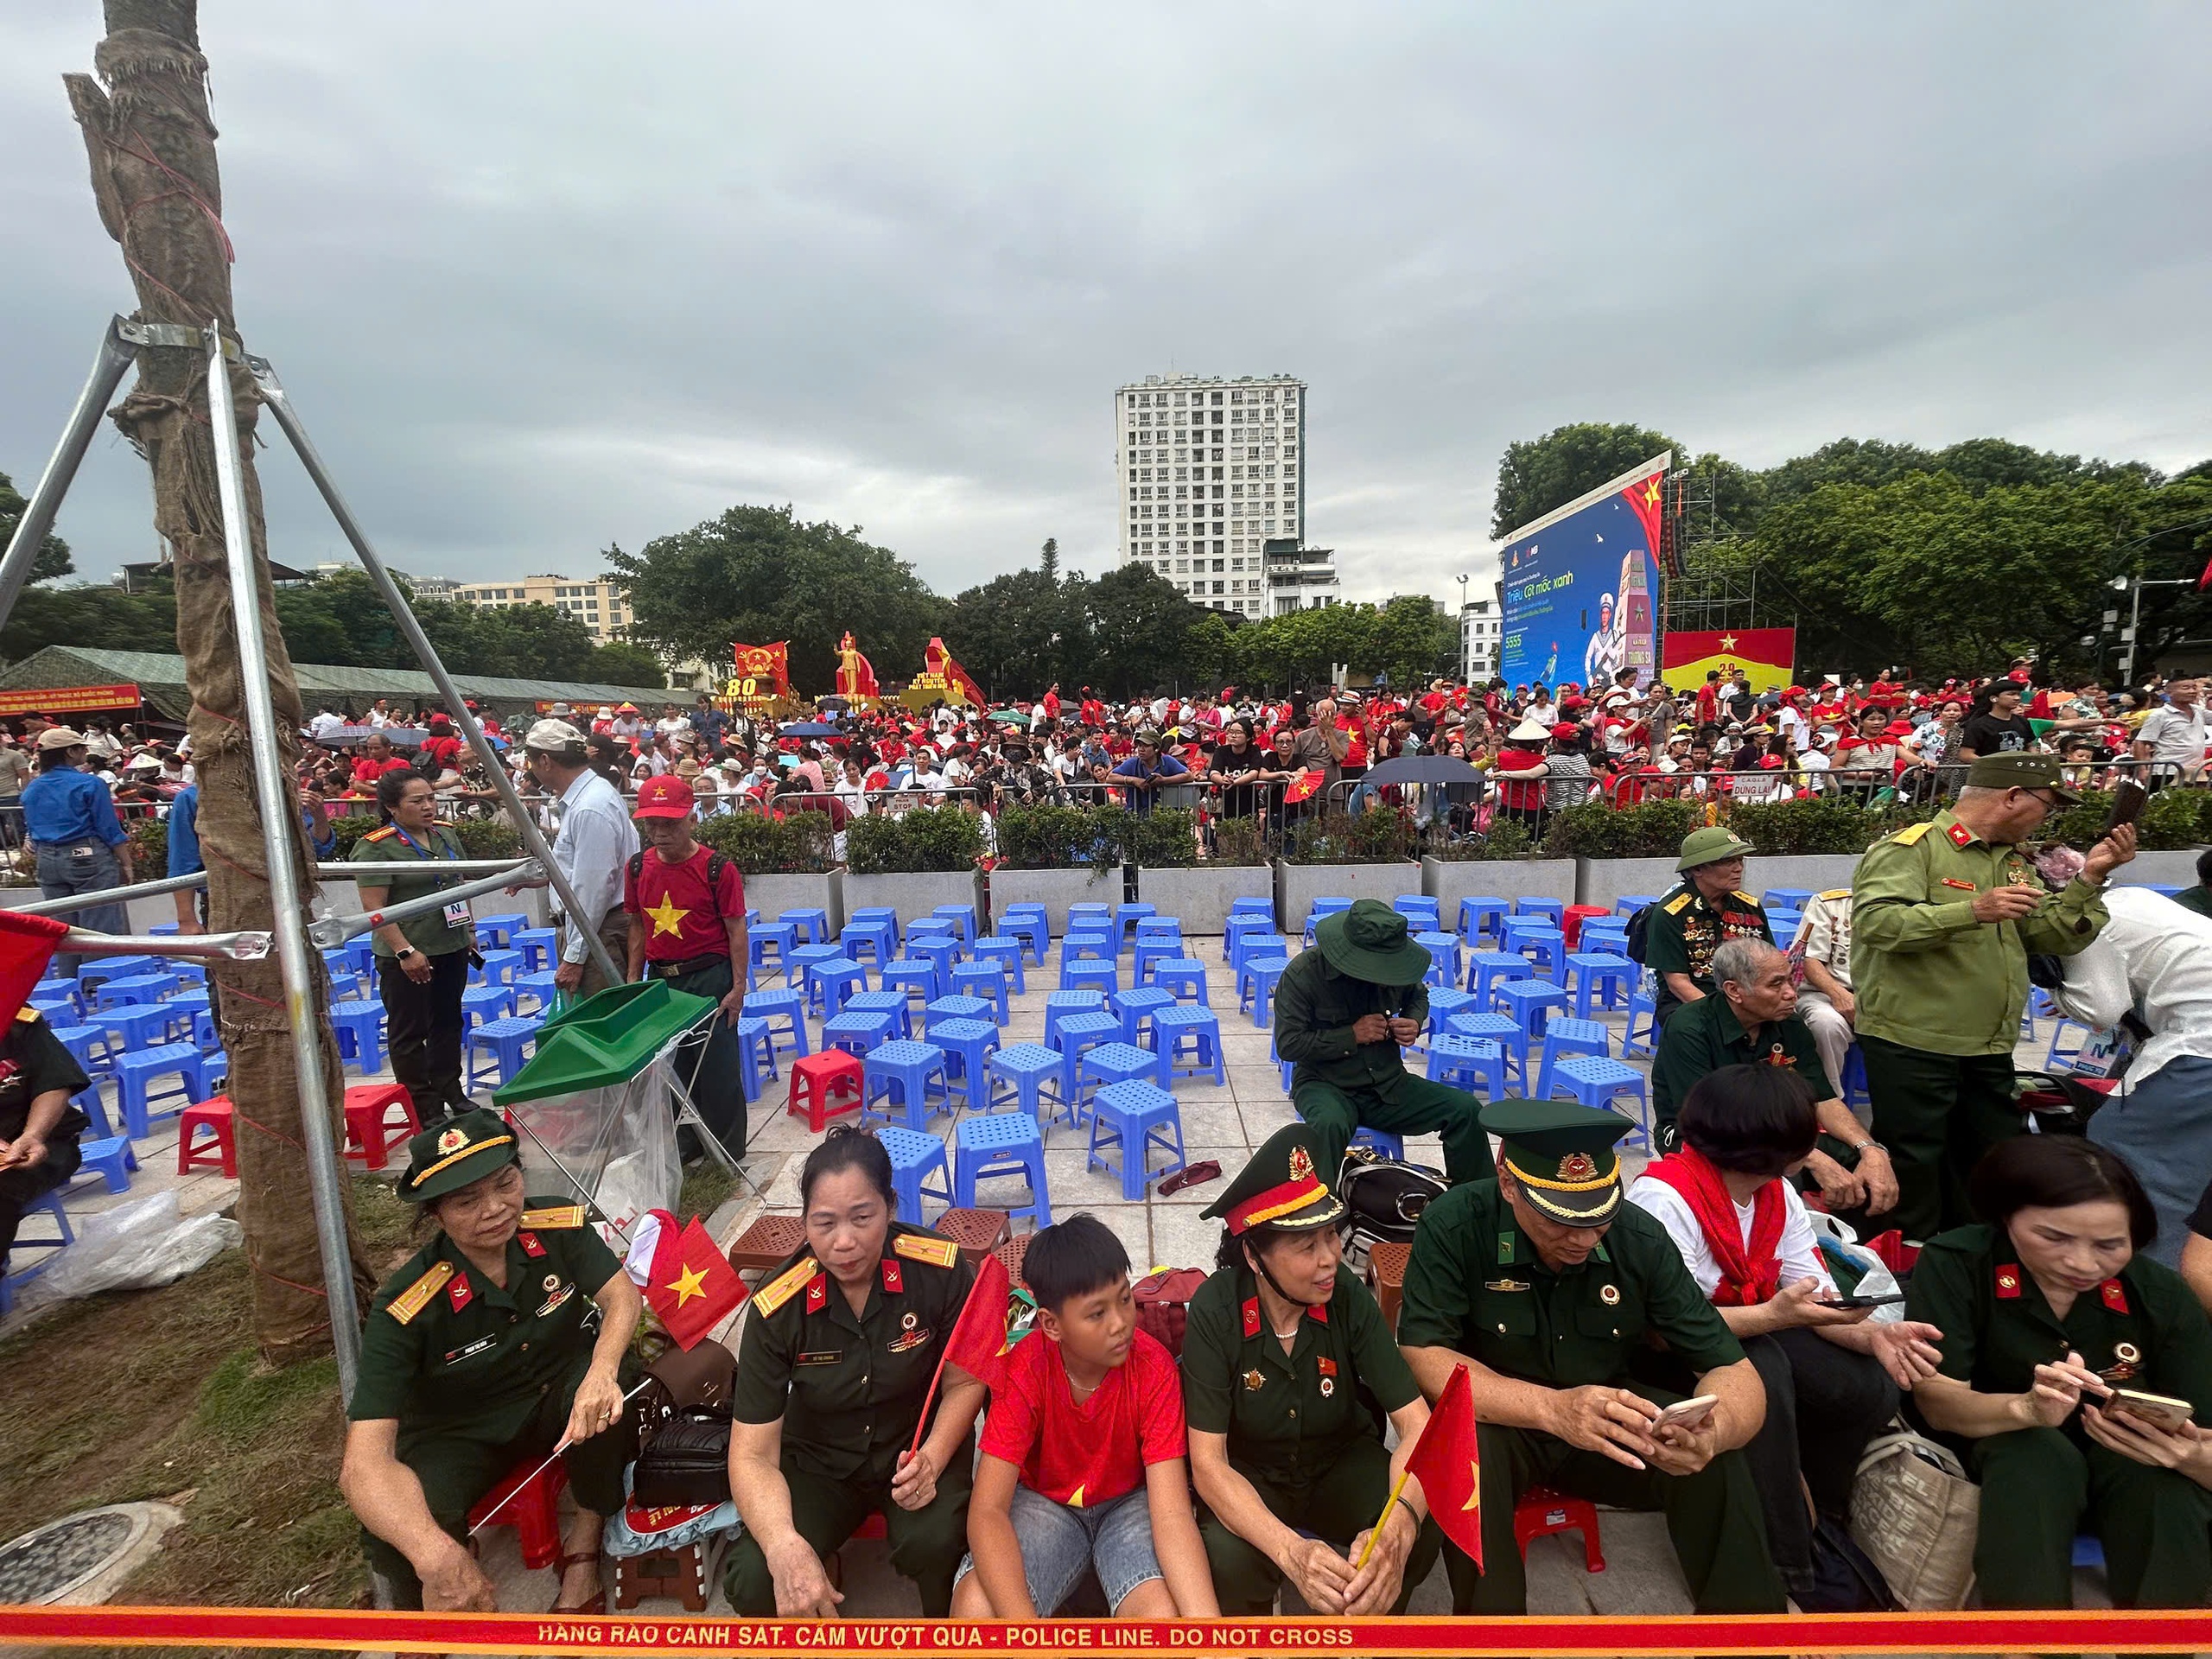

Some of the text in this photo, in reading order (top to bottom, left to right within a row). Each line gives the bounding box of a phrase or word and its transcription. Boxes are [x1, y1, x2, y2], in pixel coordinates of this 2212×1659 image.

[1535, 575, 1552, 594] mốc
[1553, 570, 1573, 589] xanh
[1506, 633, 1522, 649] 5555
[1719, 663, 1735, 677] 2-9
[726, 678, 757, 696] 80
[450, 903, 462, 915] N
[538, 1622, 602, 1643] HÀNG
[609, 1623, 659, 1643] RÀO
[855, 1626, 925, 1650] VƯỢT
[933, 1627, 983, 1647] QUA
[1006, 1627, 1091, 1647] POLICE
[1101, 1629, 1160, 1646] LINE.
[1170, 1629, 1204, 1646] DO
[1212, 1629, 1261, 1645] NOT
[1269, 1628, 1353, 1645] CROSS
